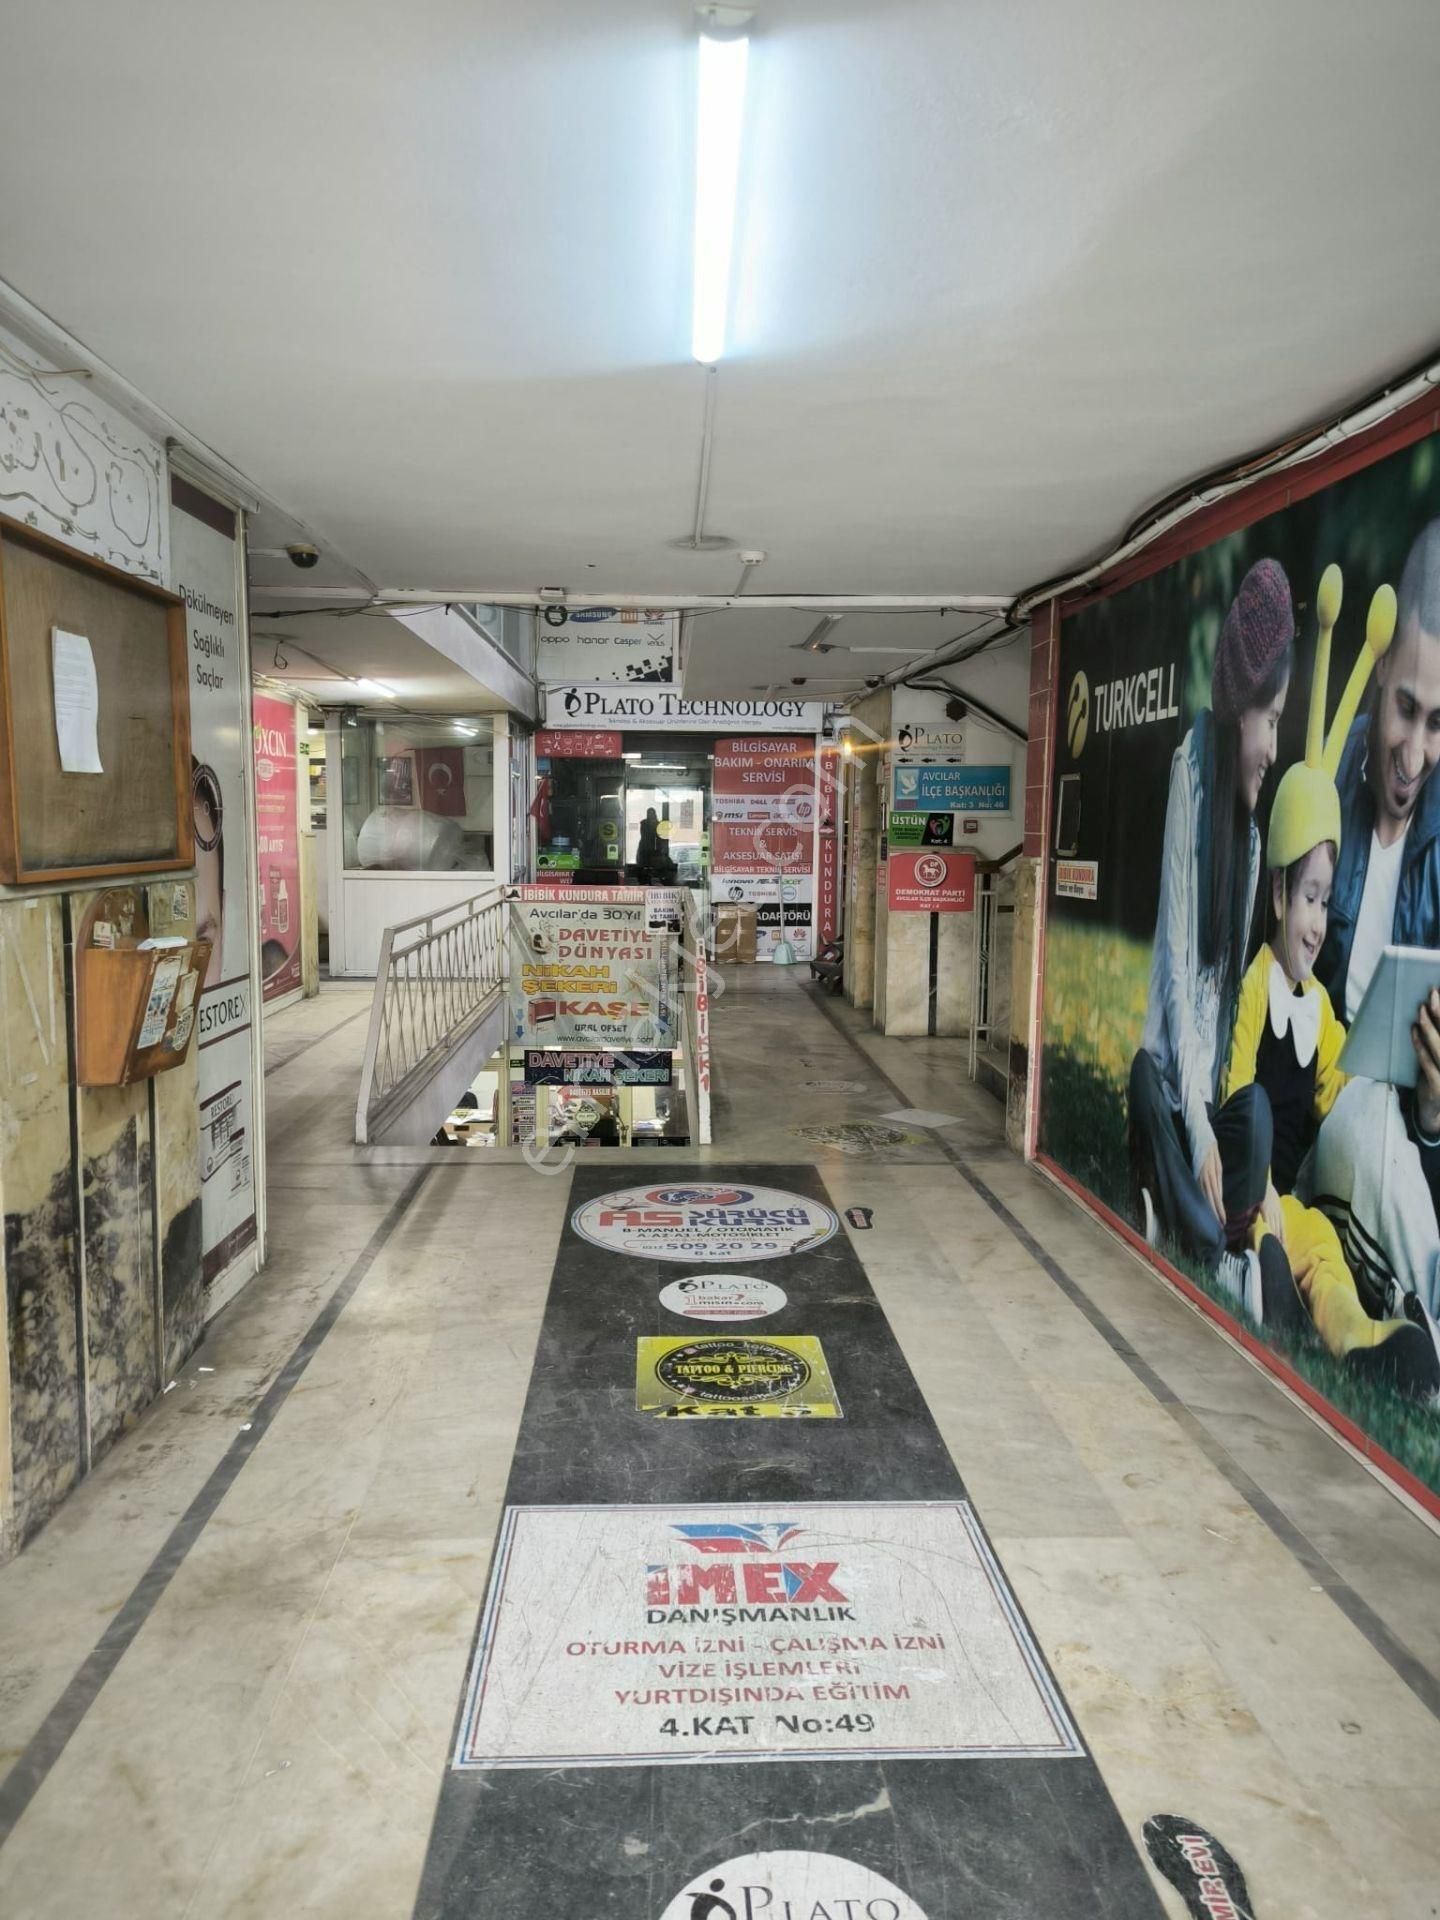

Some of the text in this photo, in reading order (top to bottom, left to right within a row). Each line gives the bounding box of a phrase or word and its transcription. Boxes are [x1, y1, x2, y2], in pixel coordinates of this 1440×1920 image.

[179, 584, 234, 625] Dökülmeyen
[193, 629, 225, 658] Sağlıklı
[541, 636, 570, 645] oppo
[577, 635, 610, 645] honor
[614, 637, 642, 647] Casper
[196, 663, 224, 692] Saçlar
[584, 692, 806, 718] PLATO TECHNOLOGY
[1095, 663, 1179, 733] TURKCELL
[914, 727, 963, 745] PLATO
[732, 740, 797, 753] BİLGİSAYAR
[715, 757, 753, 768] BAKIM
[764, 757, 815, 768] ONARIM
[743, 770, 785, 783] SERVİSİ
[922, 771, 961, 781] AVCILAR
[921, 783, 1005, 799] İLÇE BAŞKANLIĞI
[892, 814, 926, 826] ÜSTÜN
[765, 826, 798, 837] SERVİS
[759, 839, 767, 848] &
[723, 851, 772, 861] AKSESUAR
[783, 863, 811, 873] SERVİSİ
[824, 840, 833, 932] KUNDURA
[524, 887, 556, 901] İBİBİK
[558, 888, 608, 902] KUNDURA
[530, 908, 598, 920] Avcılar'da
[558, 928, 653, 943] DAVETİYE
[558, 943, 652, 960] DÜNYASI
[522, 964, 610, 978] NİKAH
[200, 992, 248, 1033] ESTOREX
[559, 1001, 650, 1020] KAŞE
[600, 1024, 628, 1032] OFSET
[528, 1052, 615, 1068] DAVETİYE
[563, 1068, 611, 1082] NİKAH
[599, 1208, 809, 1227] AS SÜRÜCÜ
[689, 1218, 811, 1227] KURSU
[716, 1225, 794, 1233] OTOMATİK
[751, 1242, 778, 1250] 29
[701, 1280, 769, 1290] PLATO
[676, 1364, 793, 1374] TATTOO & PIERCING
[646, 1606, 856, 1626] DANIŞMANLIK
[566, 1639, 686, 1657] OTURMA
[695, 1636, 745, 1654] İZNİ
[770, 1636, 887, 1656] ÇALIŞMA
[894, 1632, 946, 1651] İZNİ
[658, 1660, 861, 1681] VİZE İŞLEMLERİ
[615, 1681, 911, 1706] YURTDIŞINDA EĞİTİM
[659, 1713, 876, 1738] 4.KAT No:49
